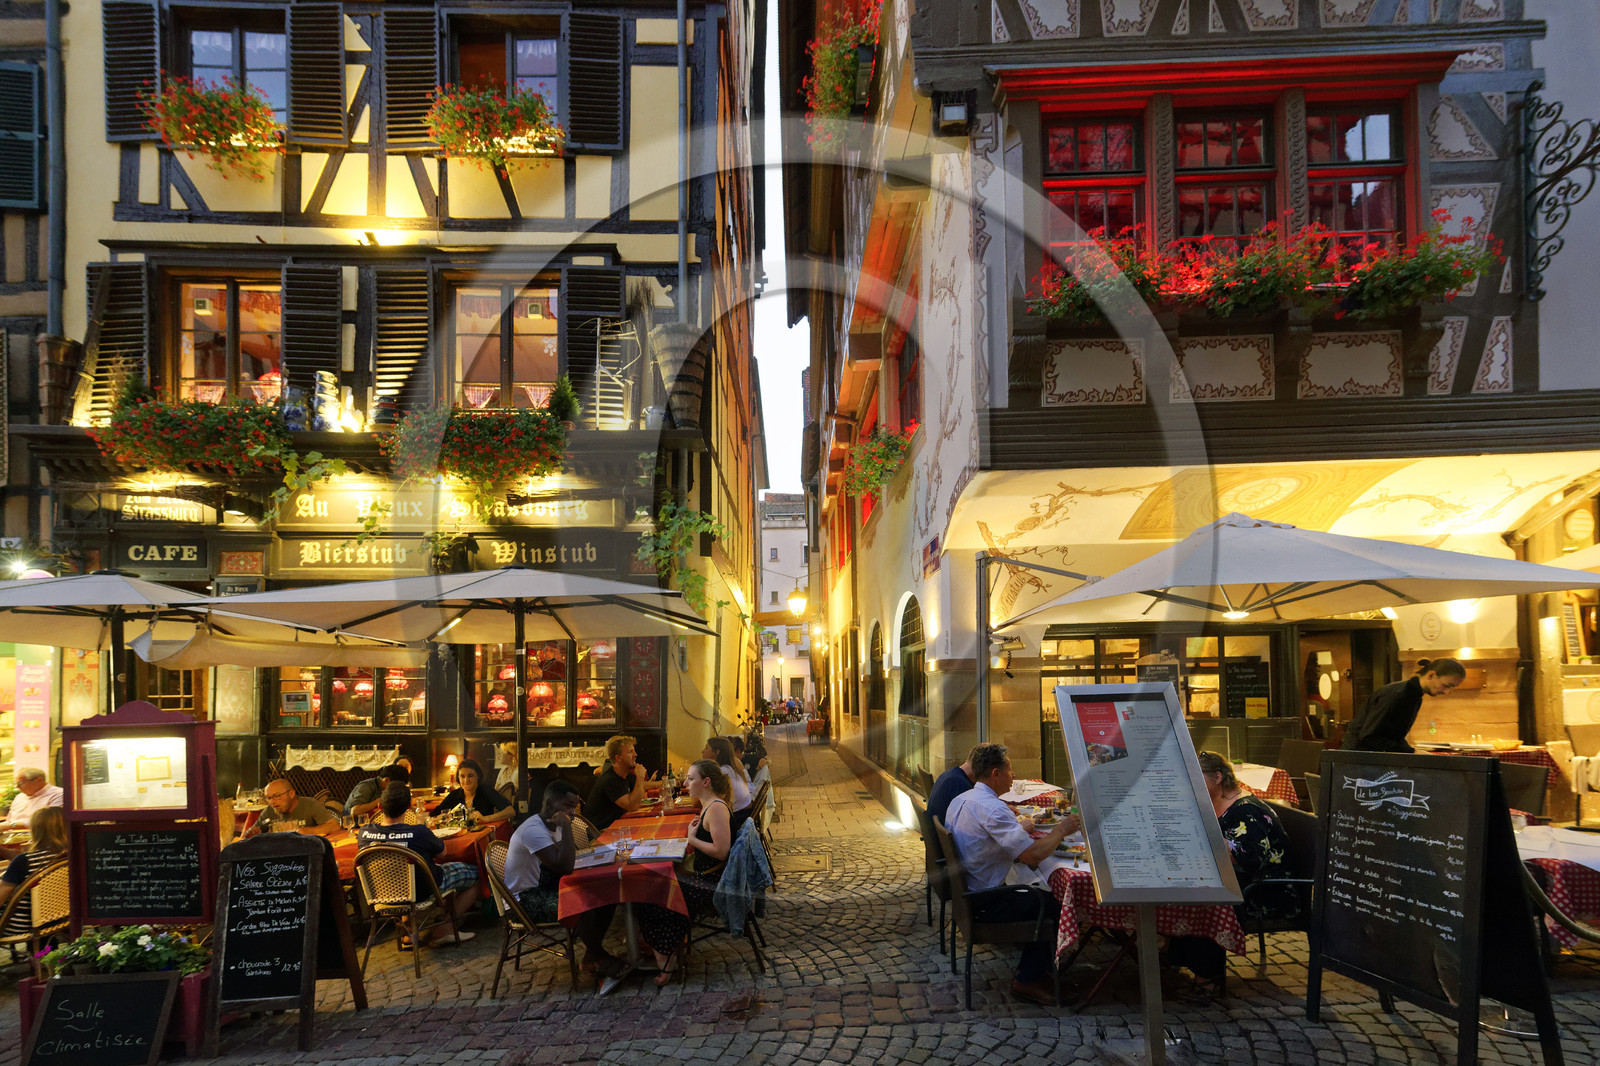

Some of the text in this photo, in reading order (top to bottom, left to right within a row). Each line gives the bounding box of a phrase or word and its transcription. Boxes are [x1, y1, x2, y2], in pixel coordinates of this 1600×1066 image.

[296, 494, 329, 518] Au
[127, 545, 198, 561] CAFE
[299, 542, 407, 566] Bierstub
[491, 541, 598, 564] Winstub
[361, 830, 414, 840] Punta Cana
[235, 862, 257, 879] Nos
[55, 999, 105, 1020] Salle
